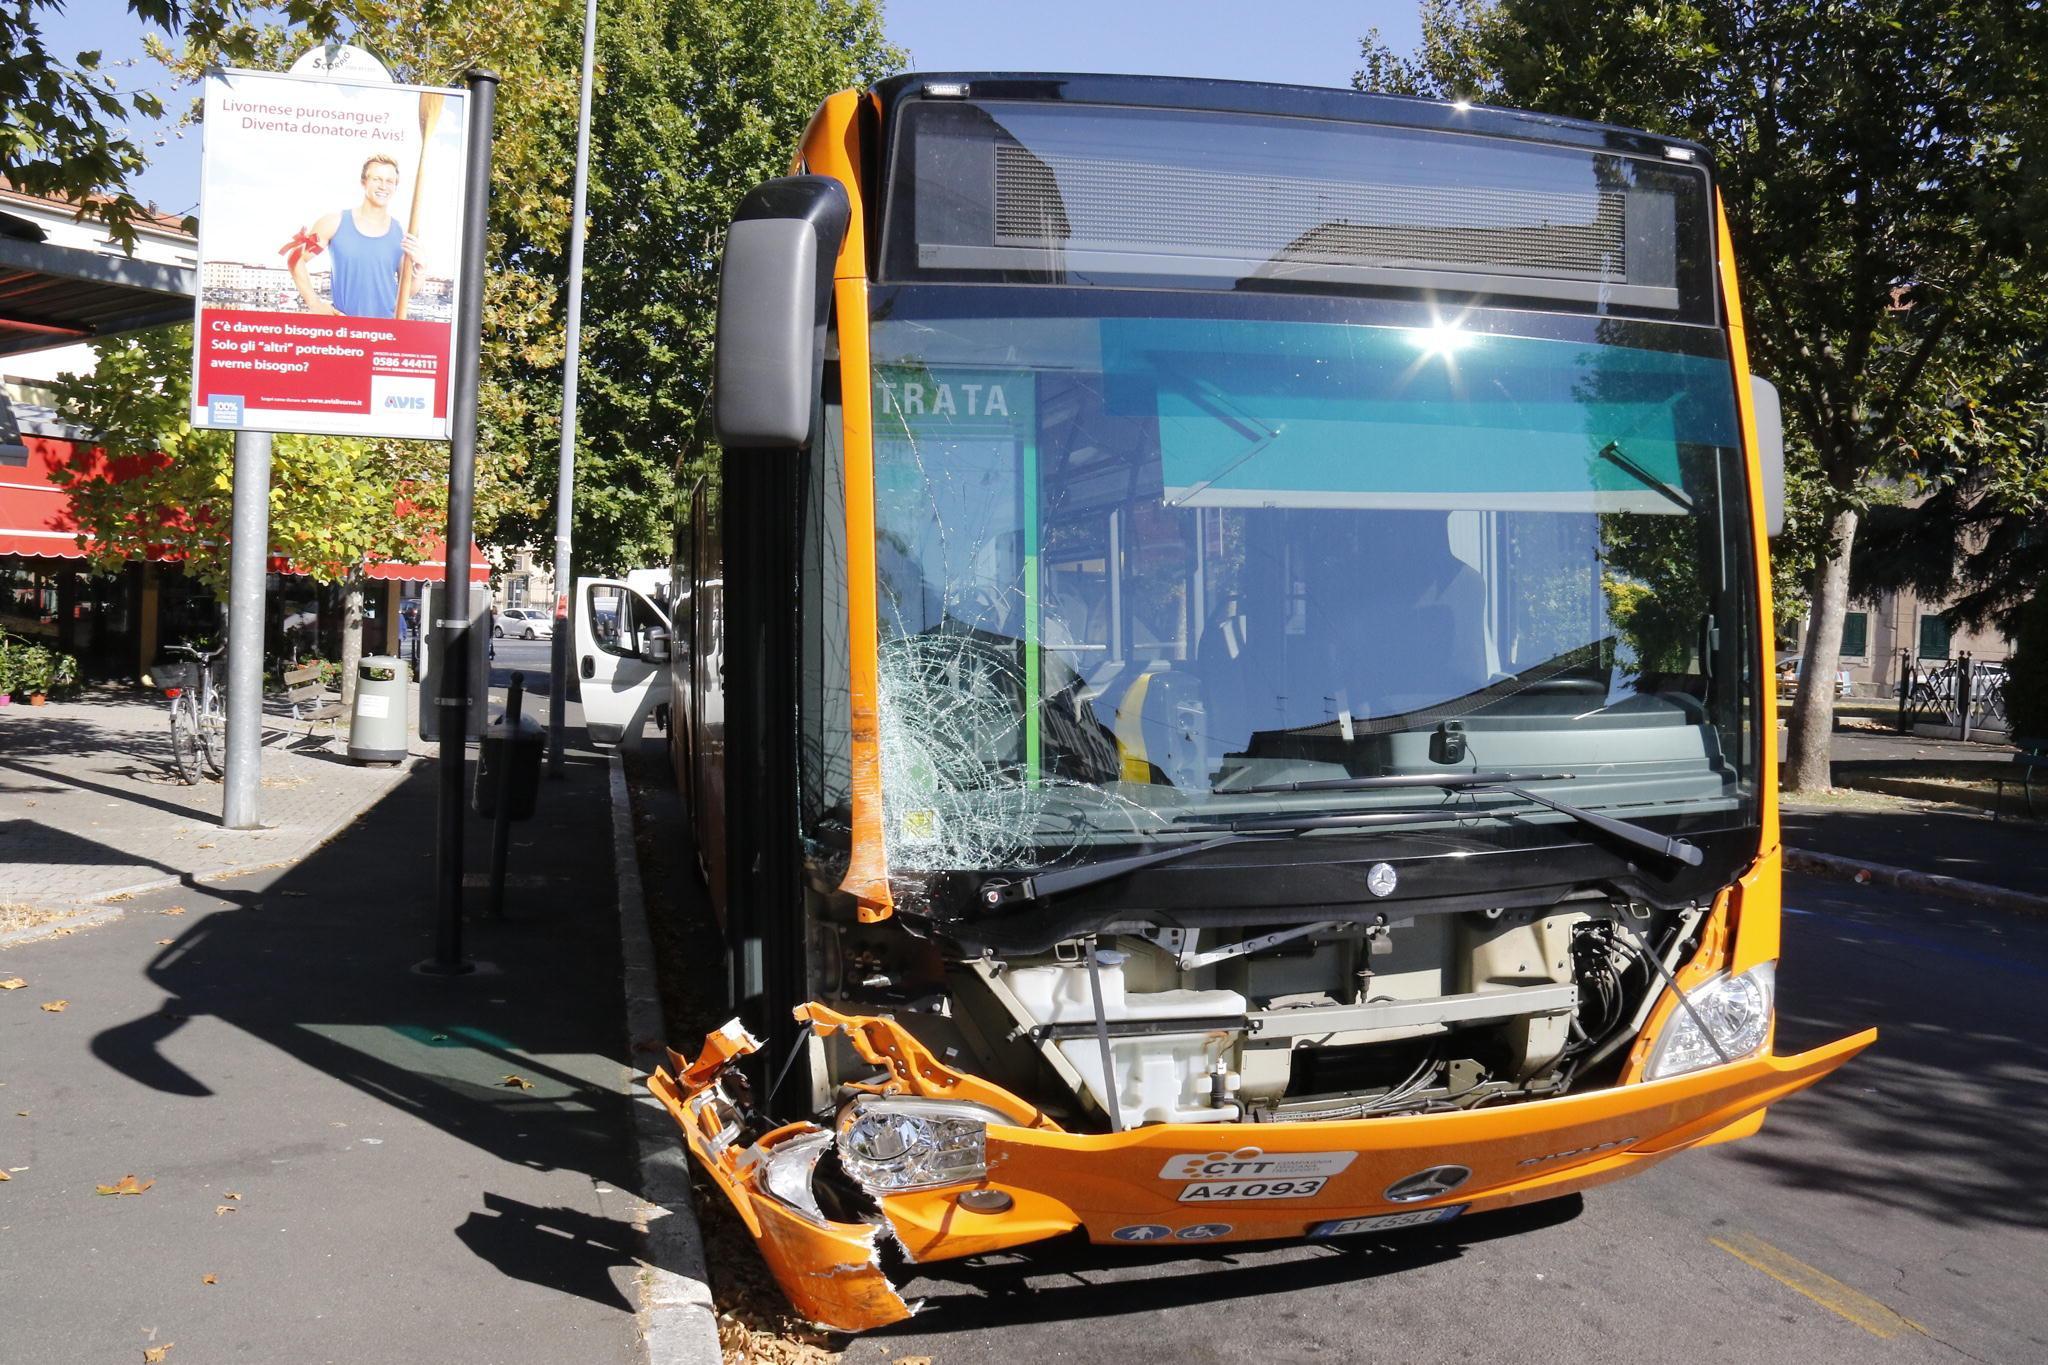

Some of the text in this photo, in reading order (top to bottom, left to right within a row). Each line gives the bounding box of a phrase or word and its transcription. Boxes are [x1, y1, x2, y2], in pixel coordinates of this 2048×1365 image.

[223, 98, 390, 125] Livornese purosangue?
[242, 117, 405, 142] Diventa donatore Avis!
[212, 321, 397, 342] C'è davvero bisogno di sangue.
[211, 339, 238, 350] Solo
[240, 340, 255, 353] gli
[258, 341, 293, 353] "altri"
[296, 344, 364, 357] potrebbero
[211, 359, 309, 373] averne bisogno?
[372, 356, 438, 369] 0586 444111
[214, 401, 238, 411] 100%
[384, 396, 426, 410] AVIS
[1203, 1162, 1275, 1174] CTT
[1186, 1181, 1321, 1199] A4093
